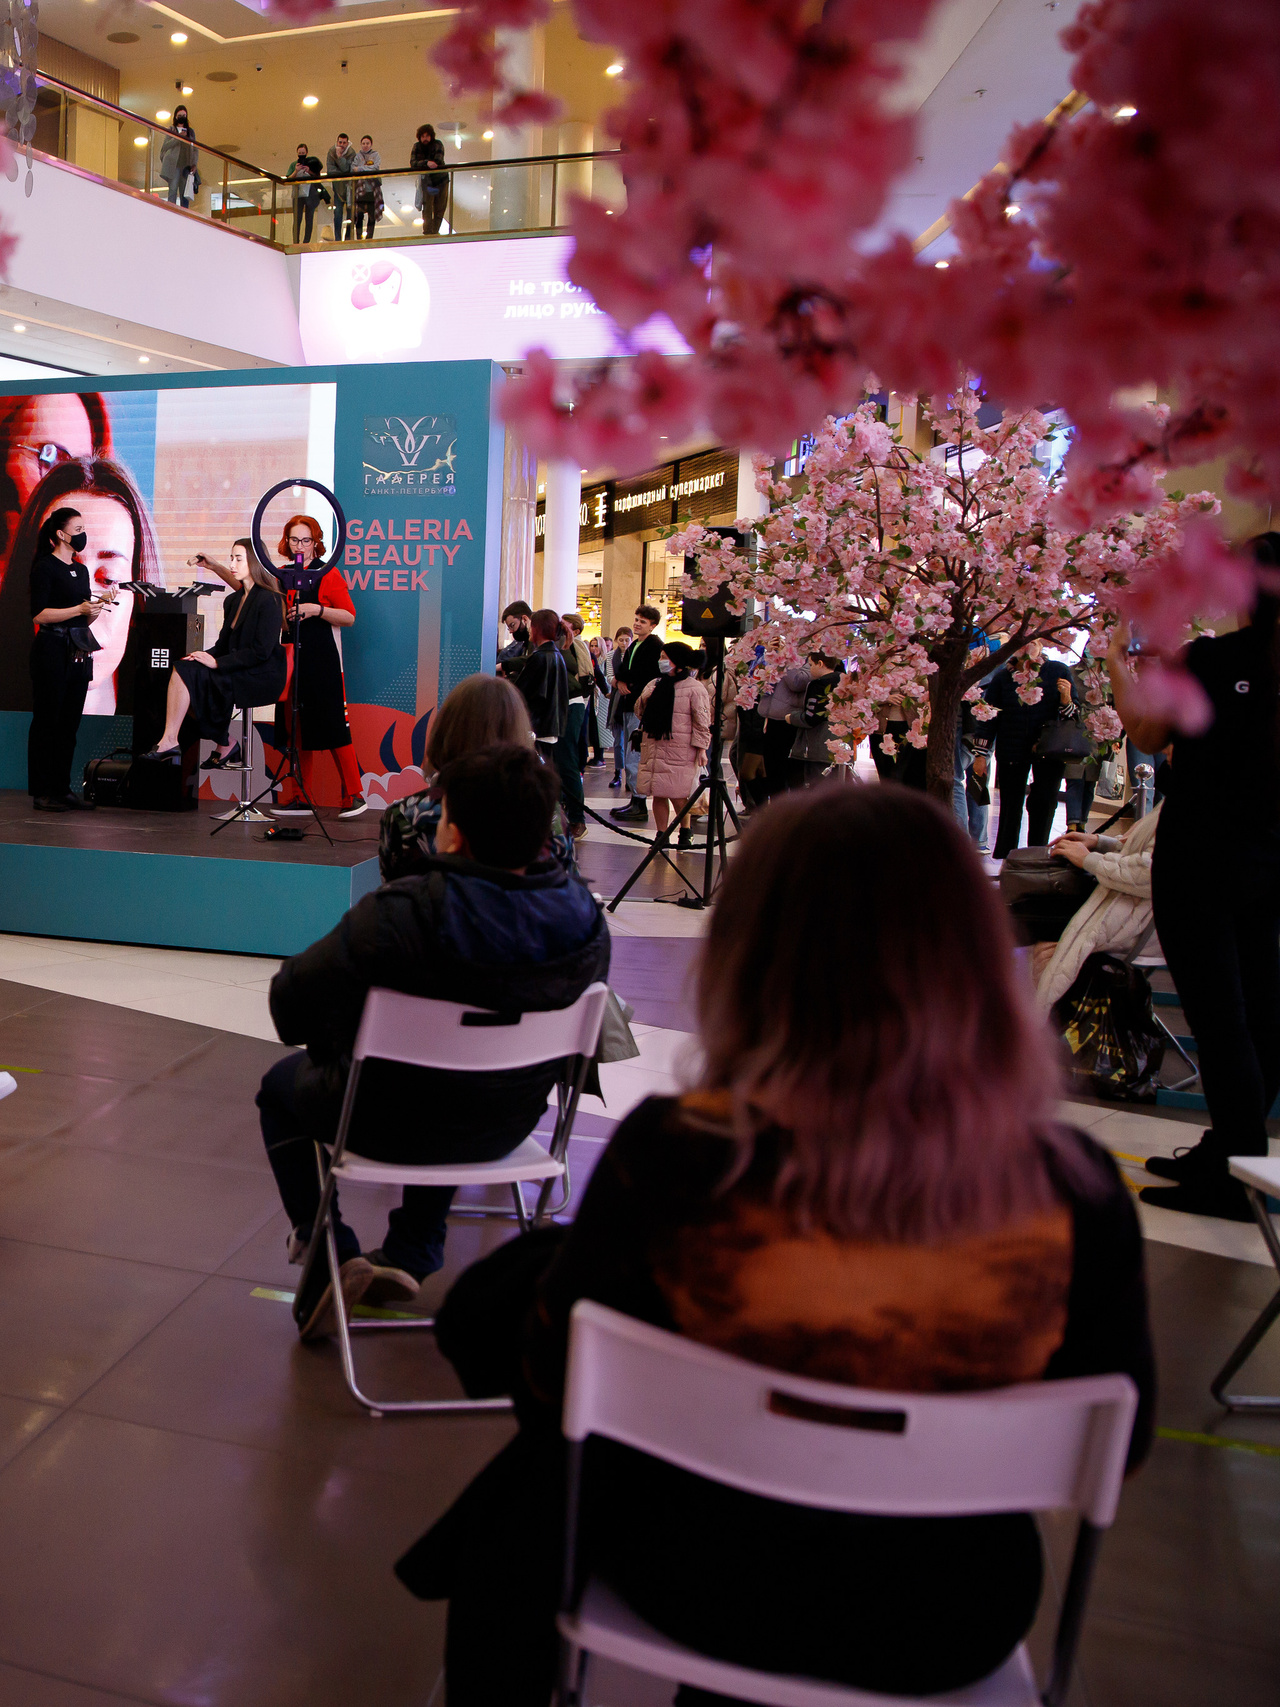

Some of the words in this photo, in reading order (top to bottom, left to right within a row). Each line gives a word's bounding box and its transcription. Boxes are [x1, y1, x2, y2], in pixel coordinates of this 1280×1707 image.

[509, 279, 536, 296] Не
[541, 279, 582, 297] тро
[504, 303, 555, 320] лицо
[614, 484, 667, 513] парфюмерный
[669, 471, 726, 501] супермаркет
[345, 518, 473, 541] GALERIA
[344, 544, 461, 566] BEAUTY
[343, 569, 430, 592] WEEK
[1234, 680, 1250, 694] G
